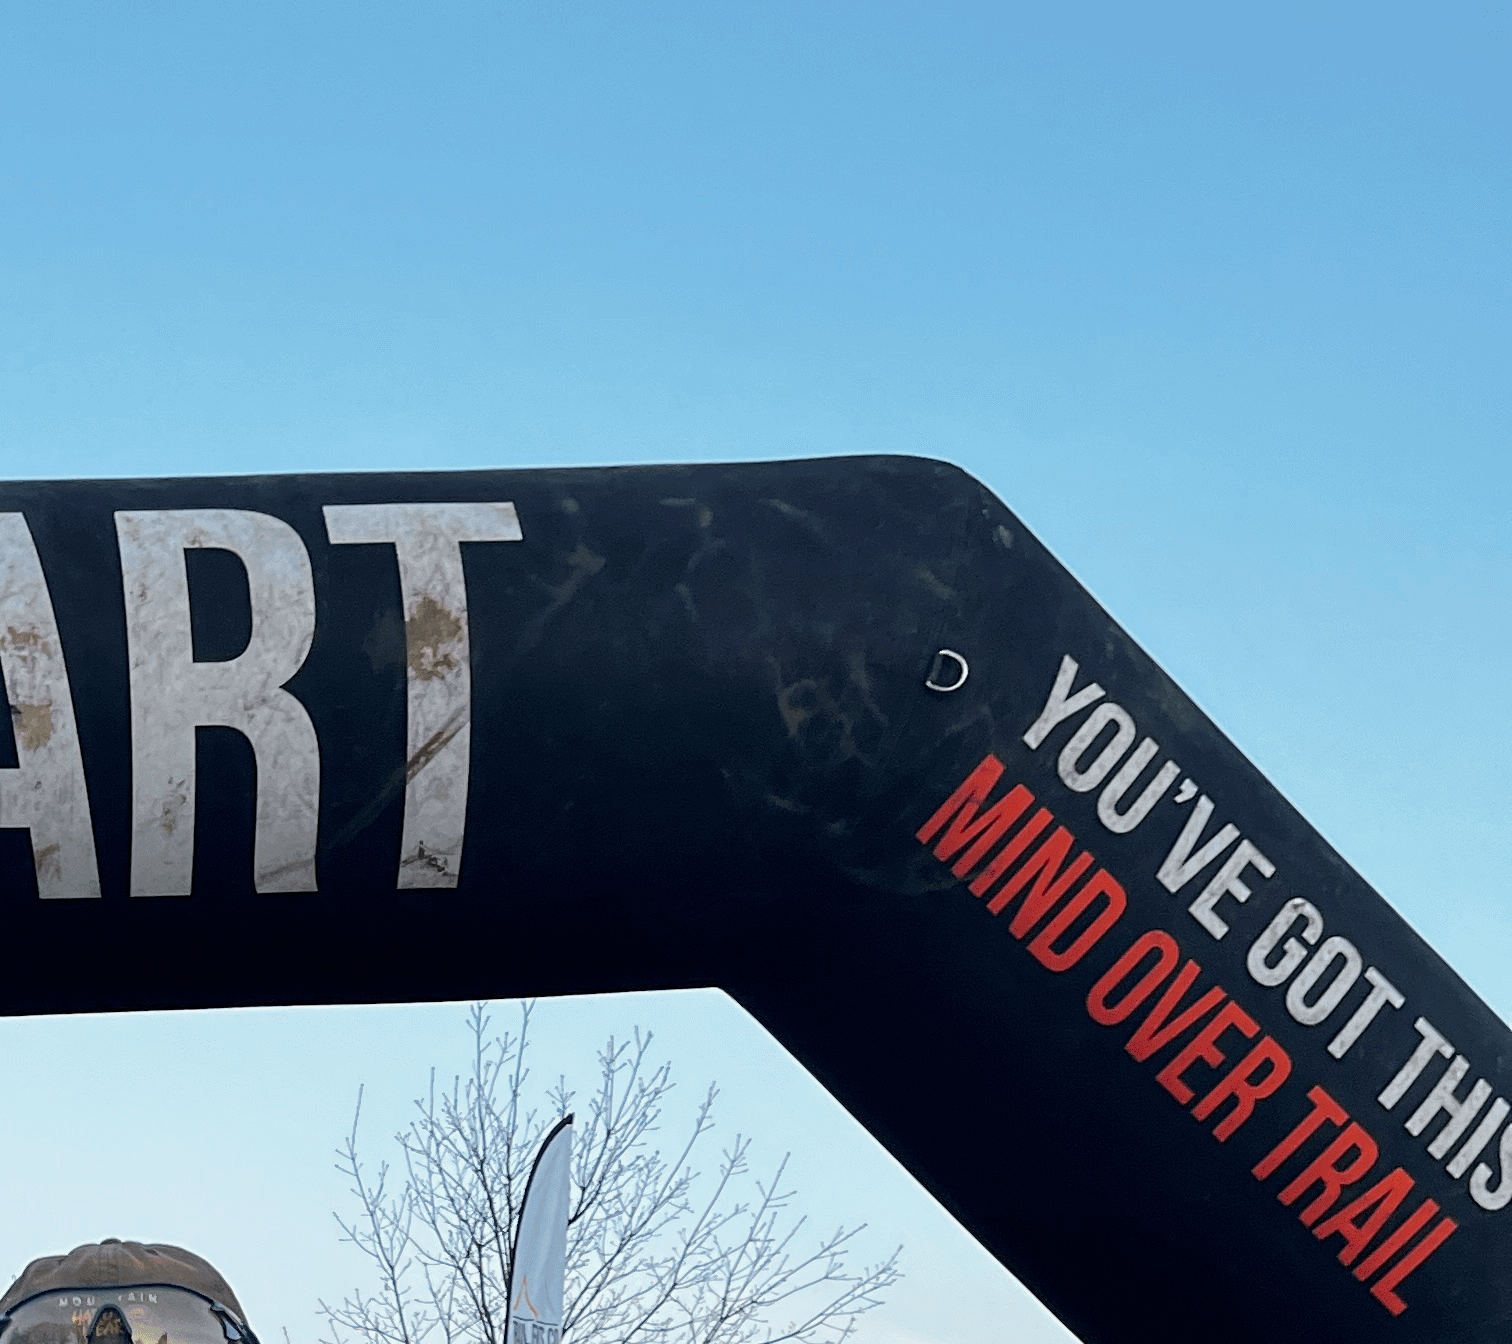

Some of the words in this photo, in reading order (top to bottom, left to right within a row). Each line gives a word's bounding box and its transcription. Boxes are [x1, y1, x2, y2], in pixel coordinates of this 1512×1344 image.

[915, 754, 1127, 972] MIND
[1086, 929, 1291, 1141] OVER
[1251, 1085, 1458, 1316] TRAIL
[1022, 654, 1275, 940] YOU'VE
[1246, 897, 1405, 1058] GOT
[1377, 1016, 1512, 1210] THIS
